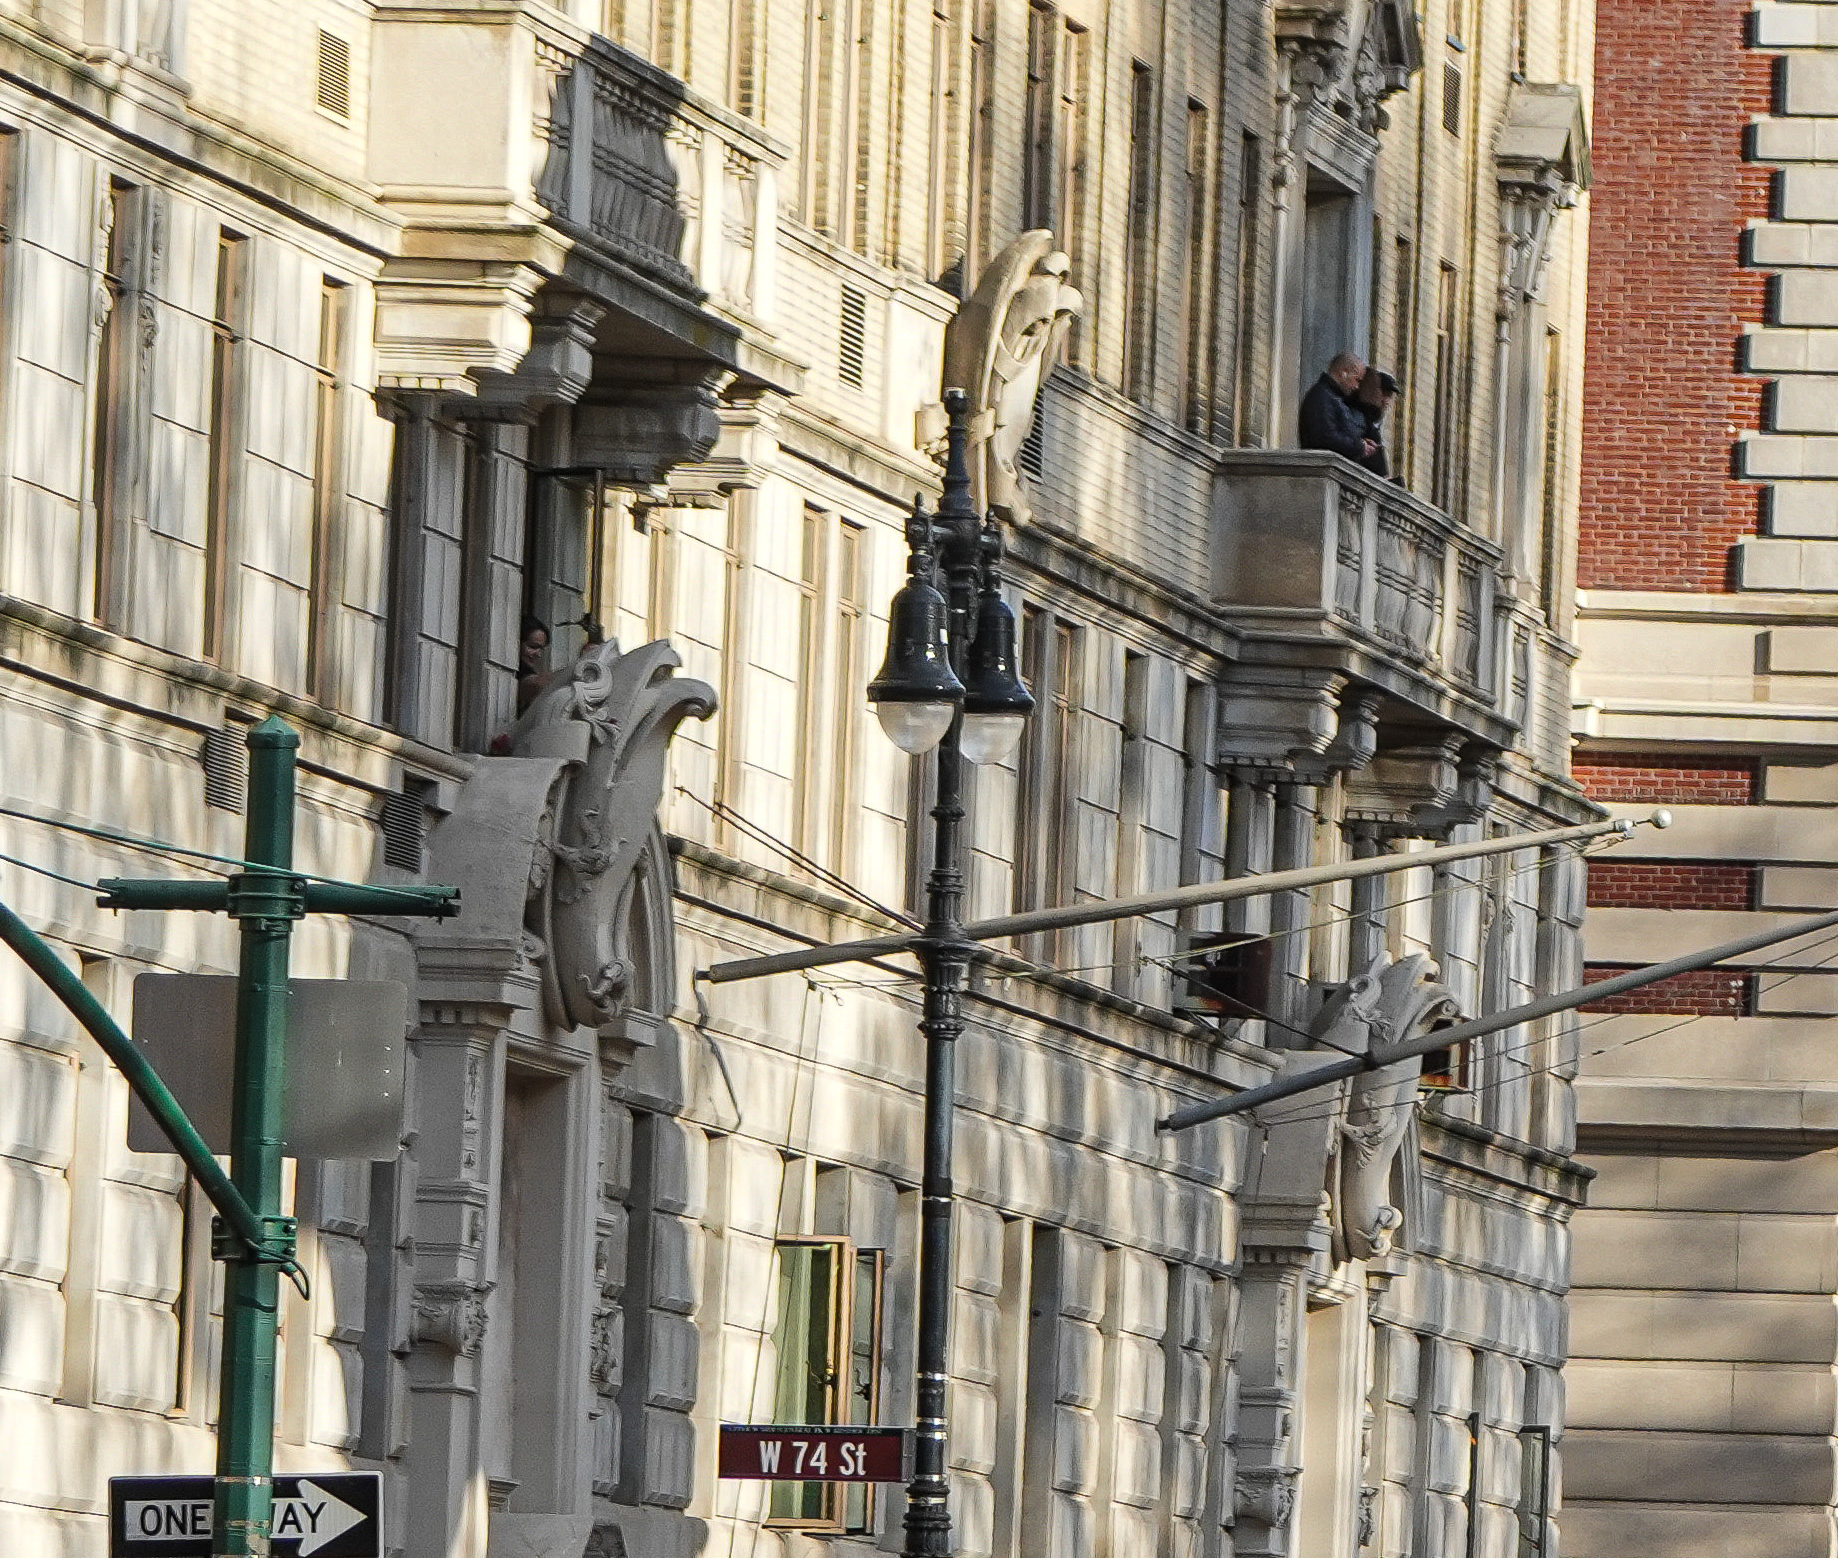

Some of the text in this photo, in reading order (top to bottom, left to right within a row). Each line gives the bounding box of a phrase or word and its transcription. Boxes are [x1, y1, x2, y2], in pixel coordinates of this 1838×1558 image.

[760, 1441, 867, 1476] W 74 St
[140, 1501, 327, 1537] ONE AY
